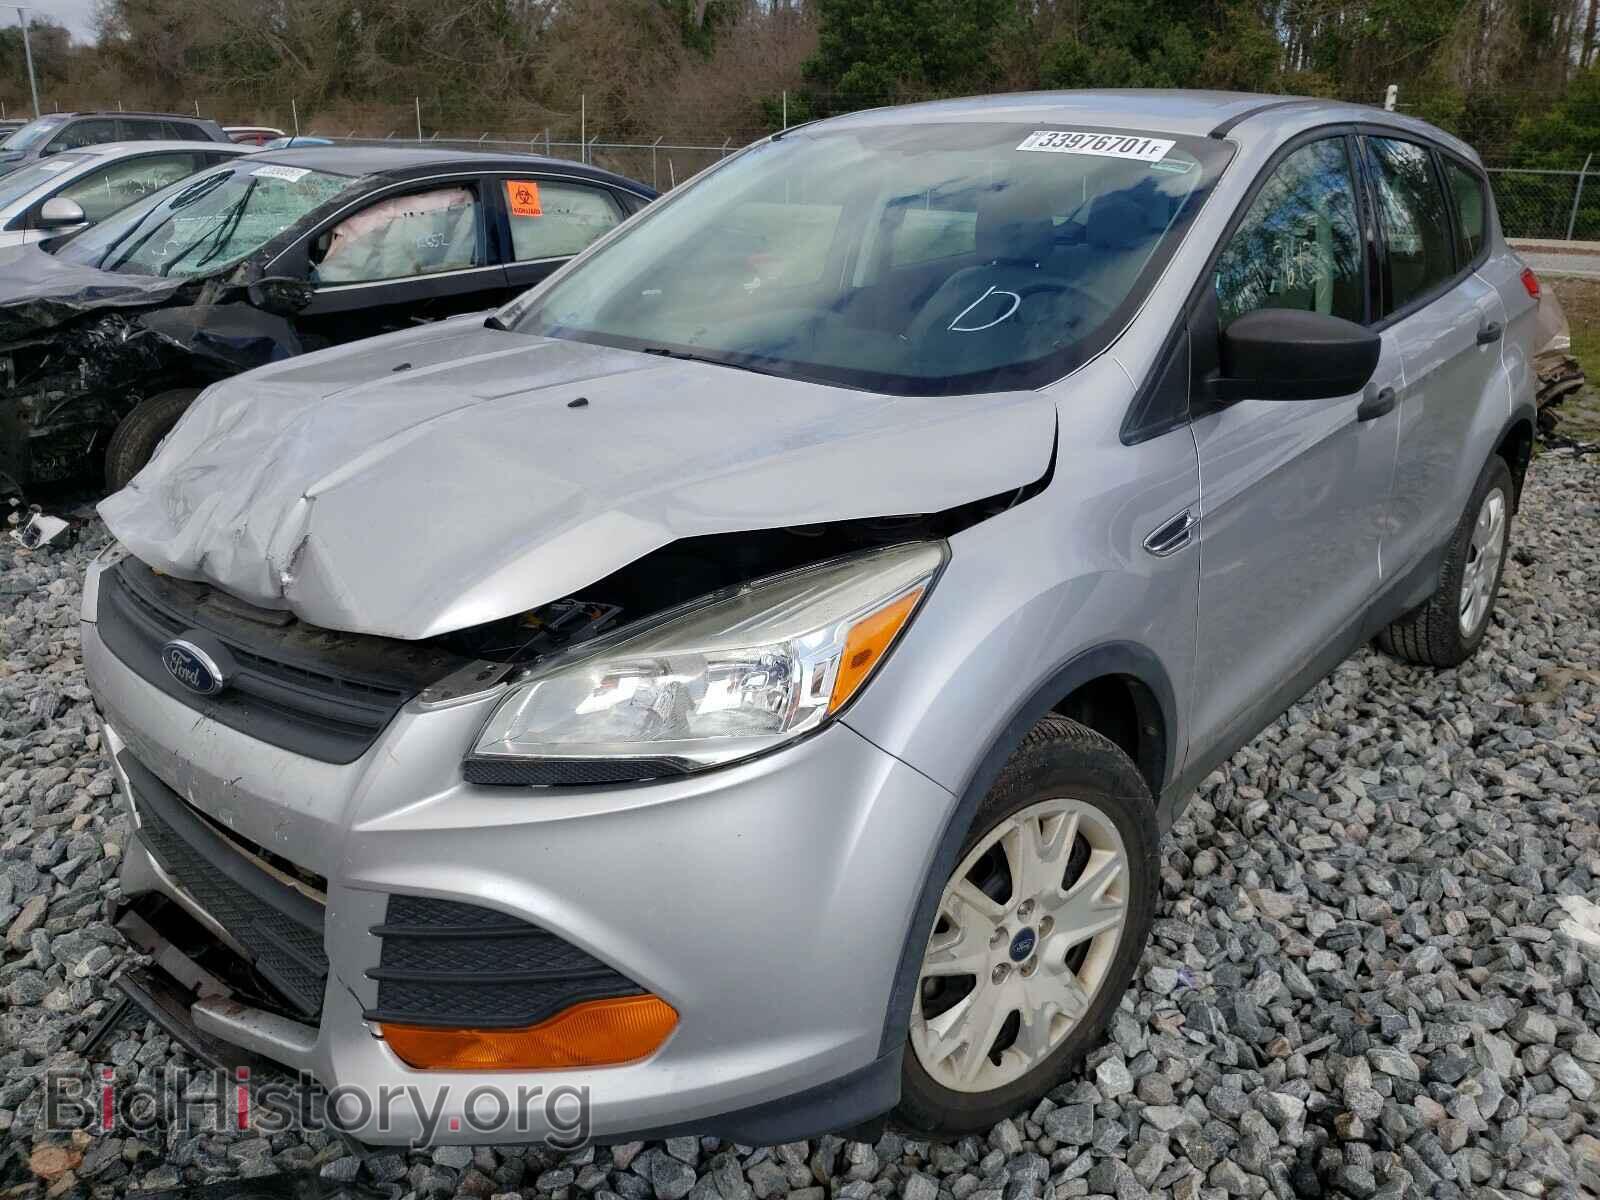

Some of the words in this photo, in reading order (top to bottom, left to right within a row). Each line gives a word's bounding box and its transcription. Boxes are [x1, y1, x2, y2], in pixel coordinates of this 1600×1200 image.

[1039, 132, 1151, 154] 33976701
[947, 285, 1021, 331] D
[170, 649, 200, 688] Ford
